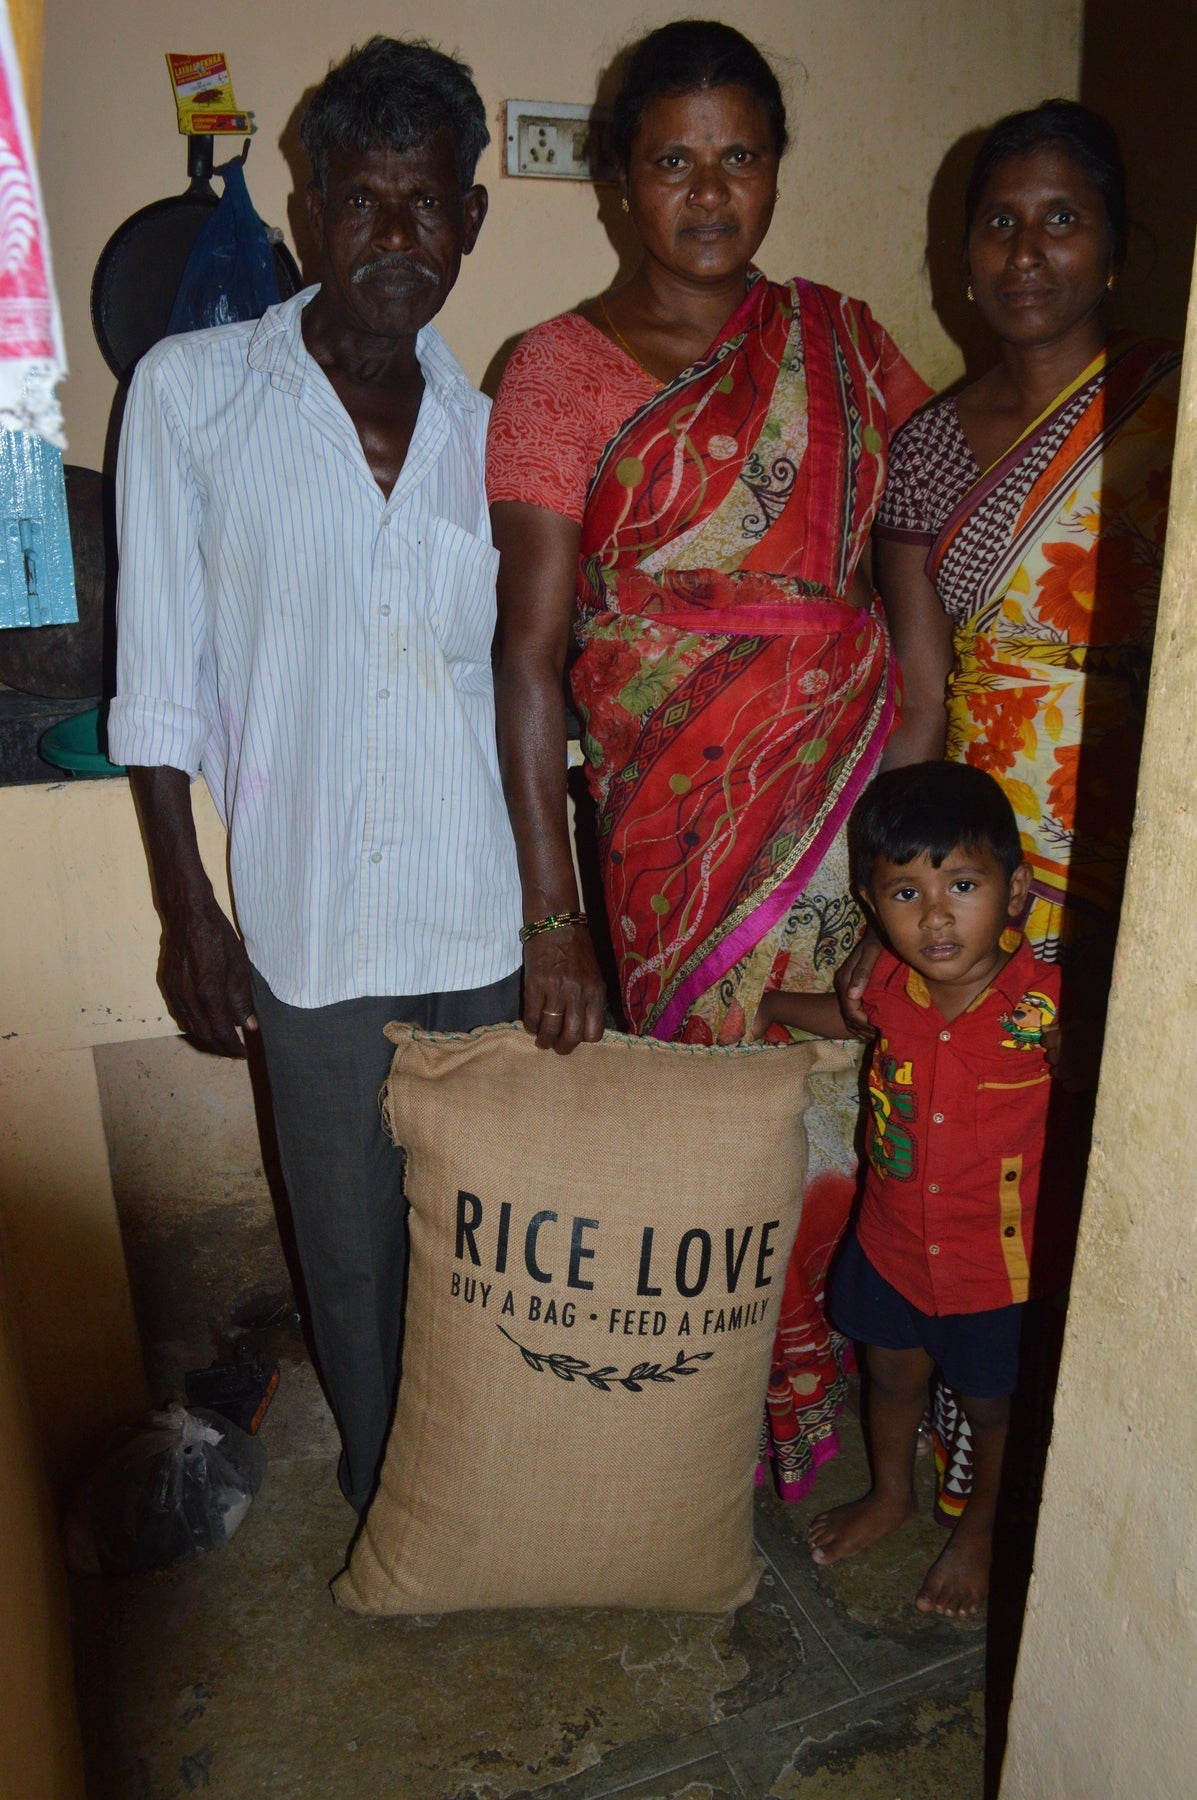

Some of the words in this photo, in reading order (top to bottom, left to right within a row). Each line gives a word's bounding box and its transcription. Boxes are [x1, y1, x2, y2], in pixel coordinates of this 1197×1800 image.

[455, 1189, 600, 1291] RICE
[636, 1219, 781, 1298] LOVE
[451, 1272, 492, 1309] BUY
[501, 1290, 515, 1317] A
[528, 1295, 577, 1329] BAG
[608, 1308, 667, 1336] FEED
[677, 1311, 691, 1337] A
[702, 1297, 770, 1335] FAMILY
